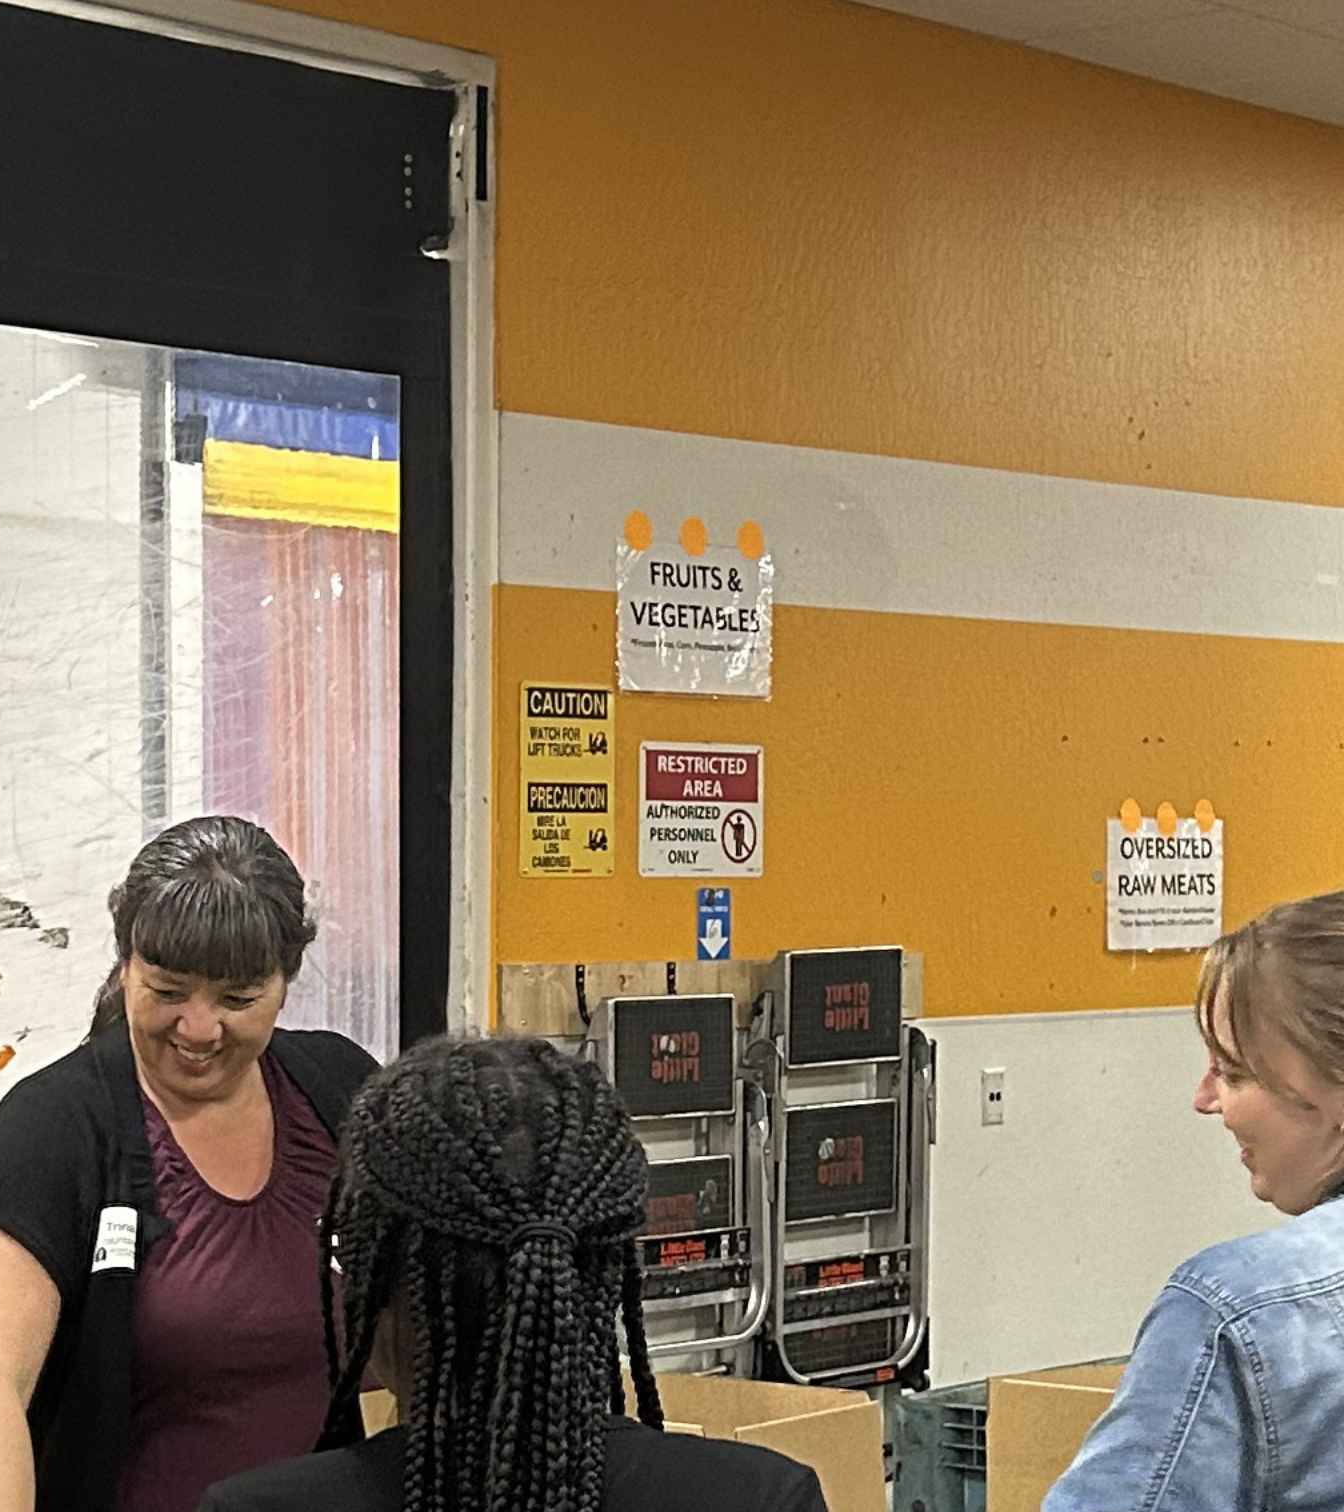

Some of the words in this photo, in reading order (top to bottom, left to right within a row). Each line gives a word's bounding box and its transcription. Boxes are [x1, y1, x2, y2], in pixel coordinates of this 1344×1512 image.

[650, 562, 723, 591] FRUITS
[727, 567, 744, 592] &
[630, 601, 761, 633] VEGETABLES
[529, 690, 606, 716] CAUTION
[657, 755, 747, 775] RESTRICTED
[530, 786, 606, 810] PRECAUCION
[682, 779, 724, 798] AREA
[646, 803, 721, 820] AUTHORIZED
[649, 827, 717, 843] PERSONNEL
[668, 850, 699, 865] ONLY
[1119, 836, 1214, 860] OVERSIZED
[1117, 874, 1157, 897] RAW
[1160, 873, 1216, 896] MEATS
